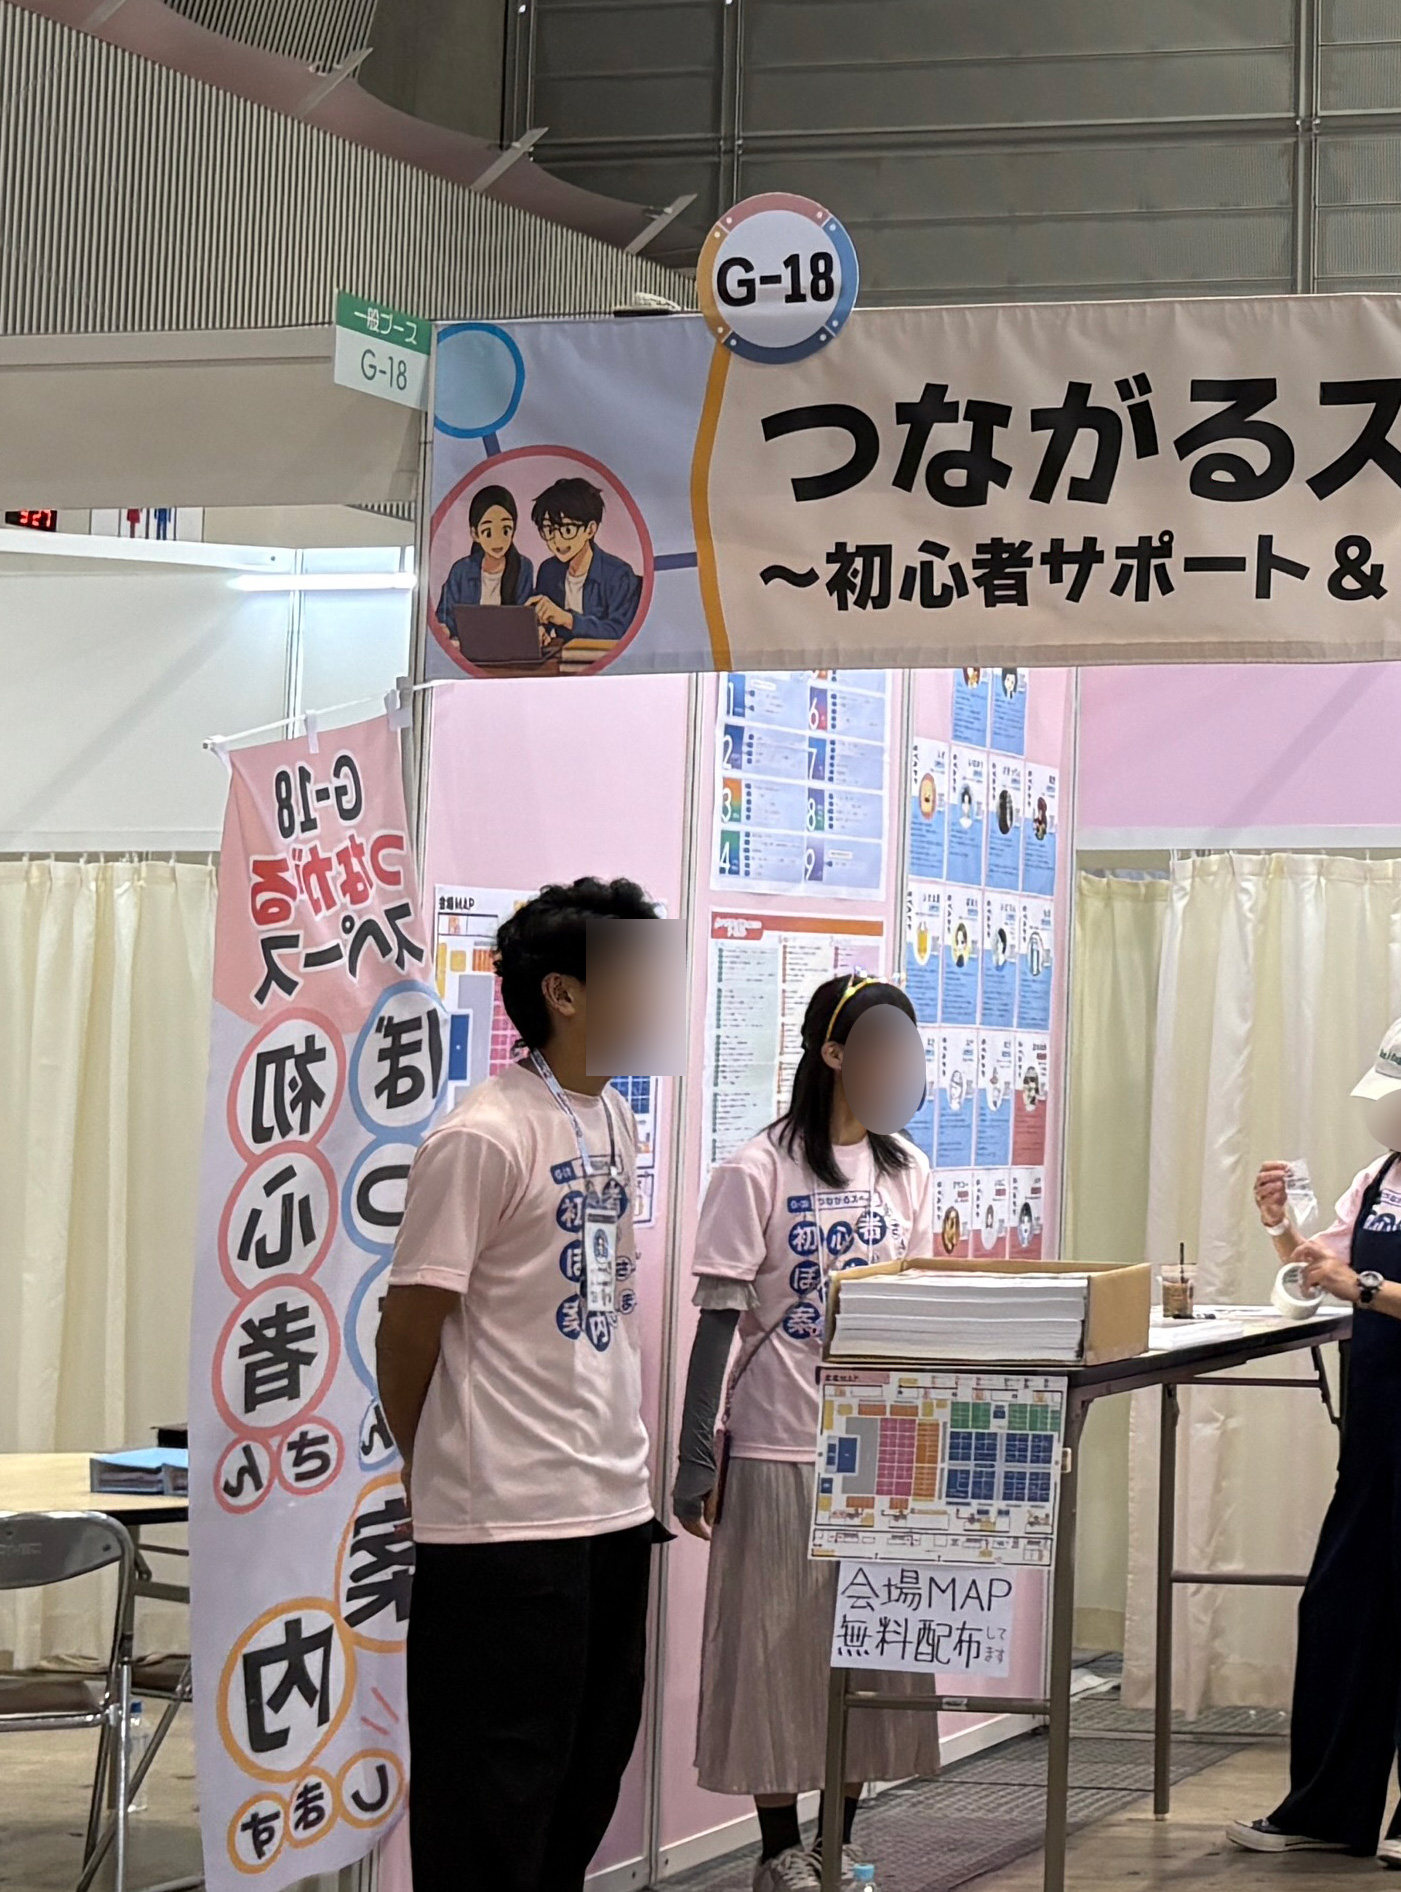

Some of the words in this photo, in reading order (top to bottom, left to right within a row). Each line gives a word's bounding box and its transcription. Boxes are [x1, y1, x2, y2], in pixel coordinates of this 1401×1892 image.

[716, 251, 836, 307] G-18
[353, 307, 418, 345] 一般ブース
[361, 348, 408, 391] G-18
[728, 682, 735, 716] 1
[809, 697, 819, 730] 6
[722, 734, 733, 769] 2
[808, 748, 818, 780] 7
[721, 787, 732, 822] 3
[807, 798, 816, 831] 8
[720, 841, 731, 875] 4
[805, 848, 815, 881] 9
[841, 1566, 1013, 1613] 会場MAP
[836, 1614, 983, 1669] 無料配布
